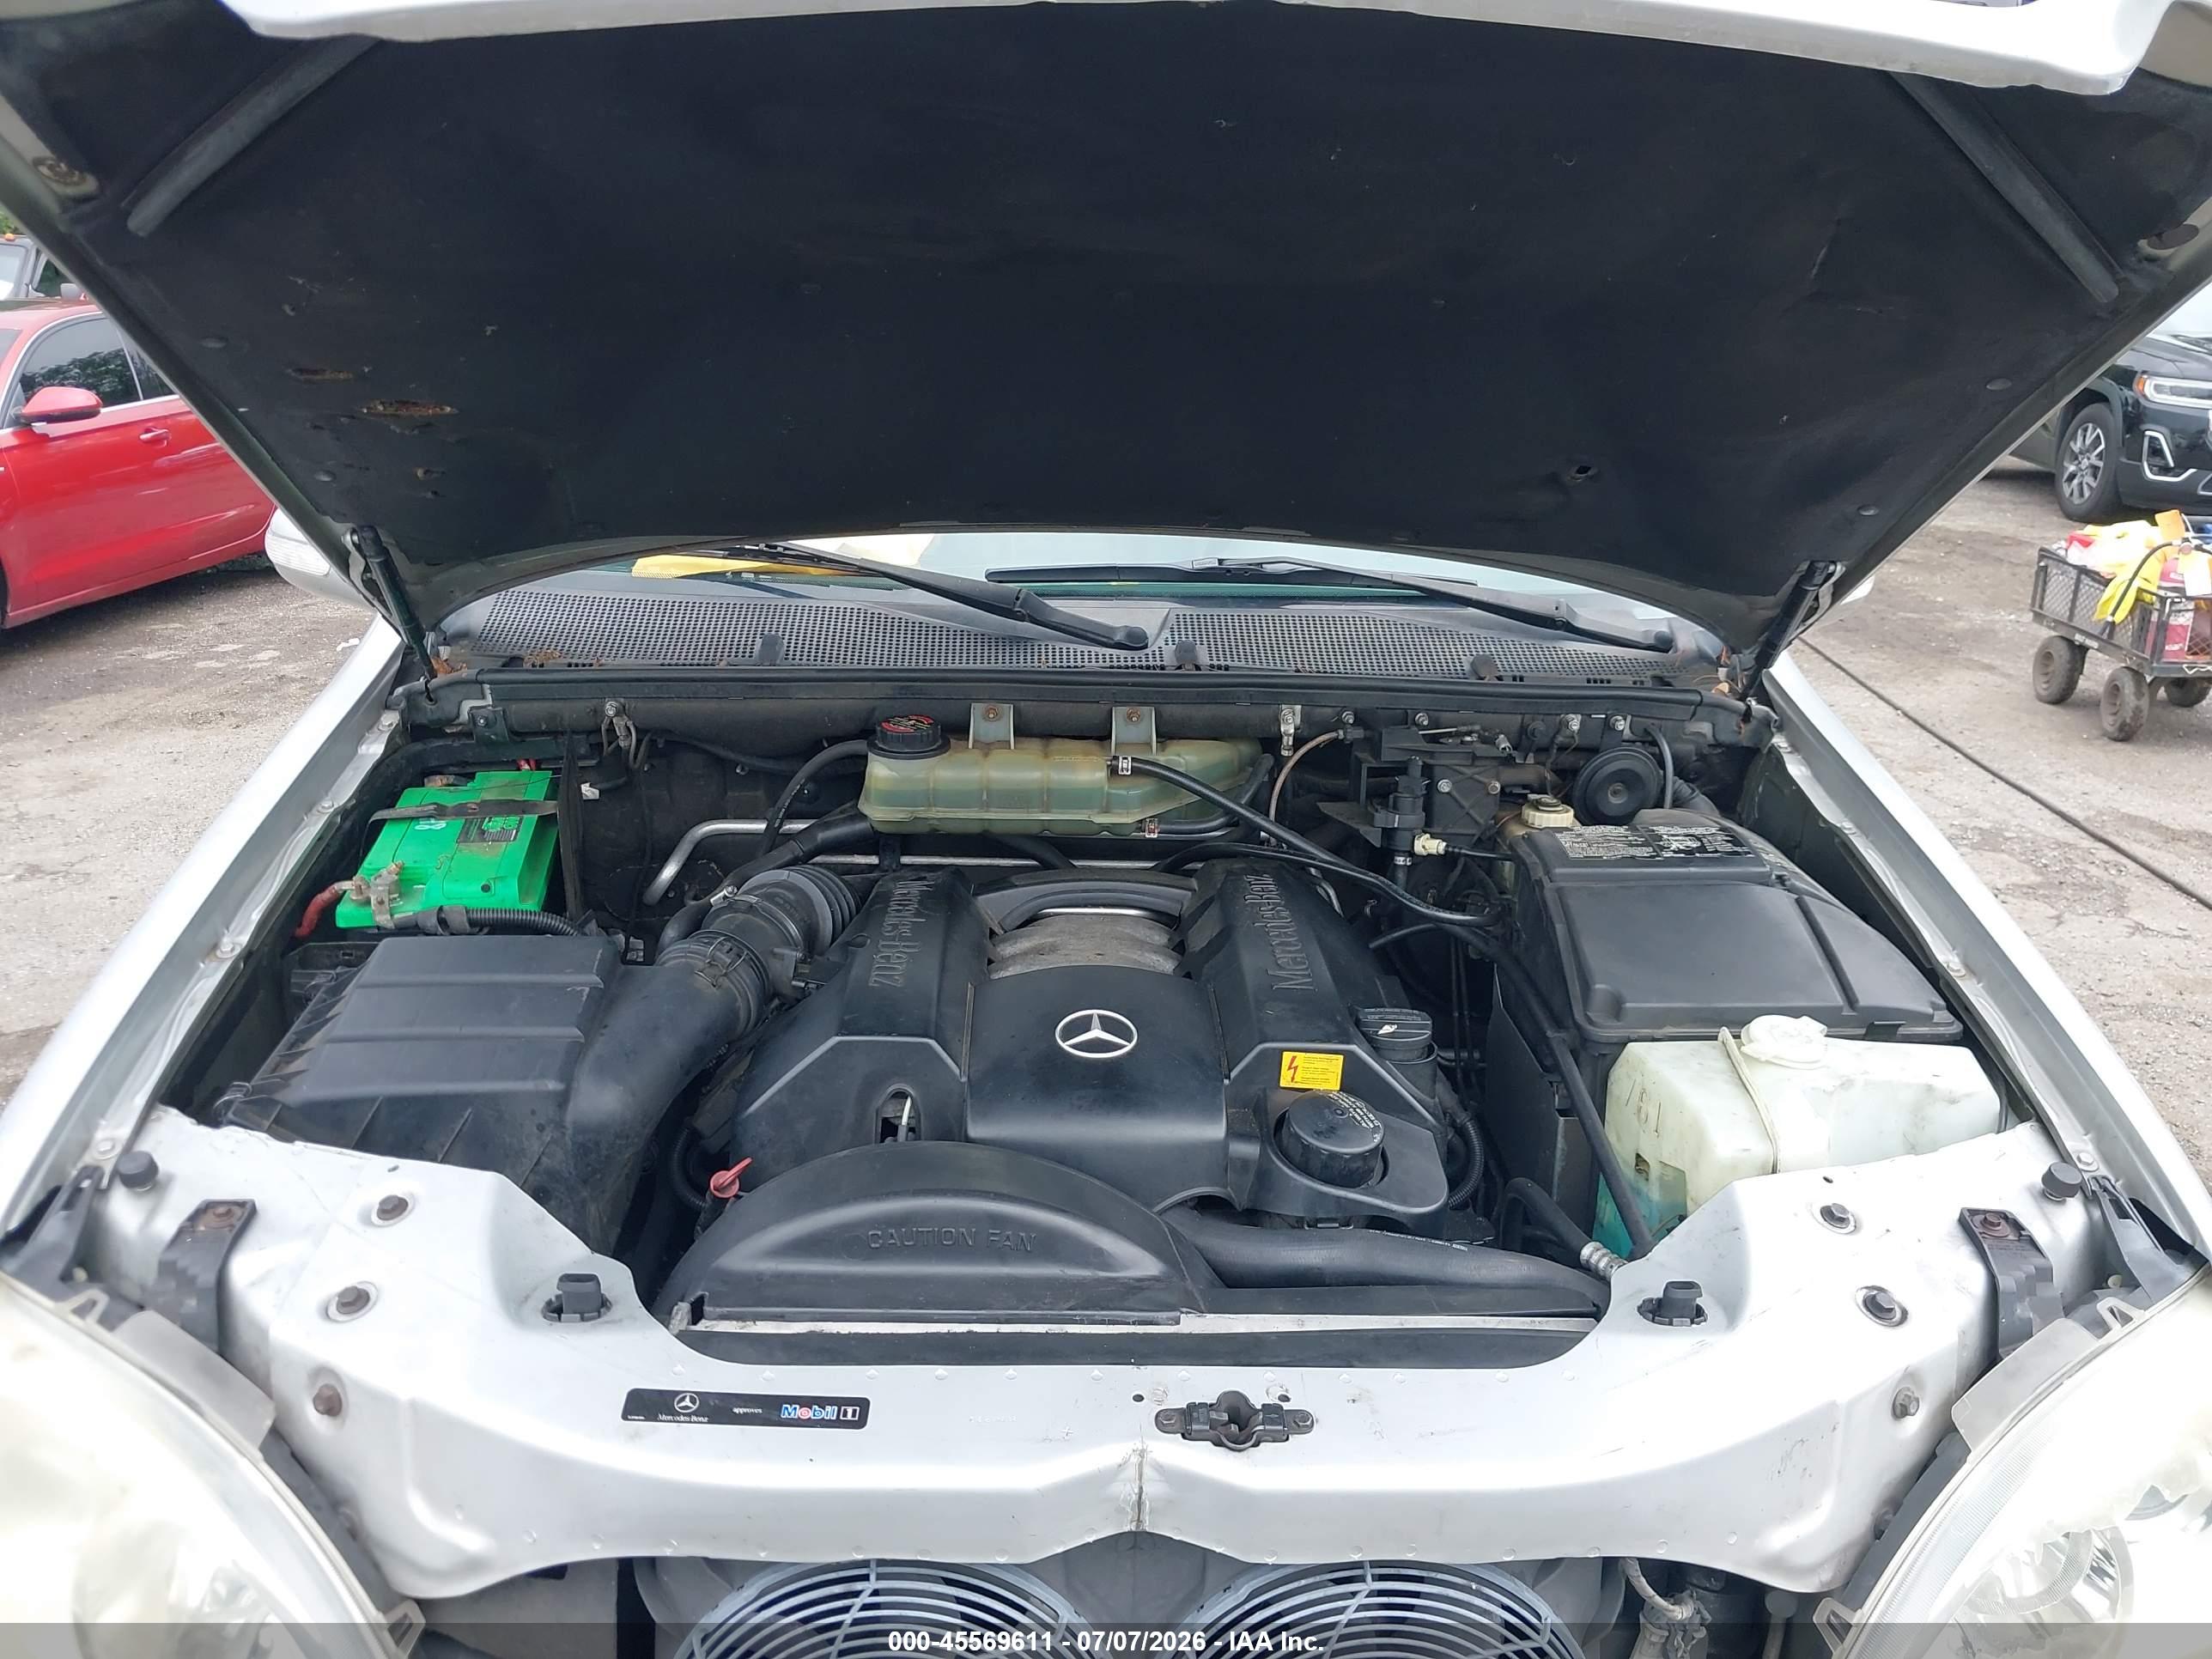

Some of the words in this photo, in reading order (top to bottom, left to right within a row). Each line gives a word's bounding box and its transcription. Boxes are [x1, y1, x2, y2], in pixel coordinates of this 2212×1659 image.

[869, 880, 935, 987] Mercedes-Benz
[1244, 874, 1318, 992] Mercedes-Benz
[867, 1228, 975, 1249] CAUTION
[988, 1230, 1036, 1251] FAN
[781, 1405, 838, 1419] Mobil
